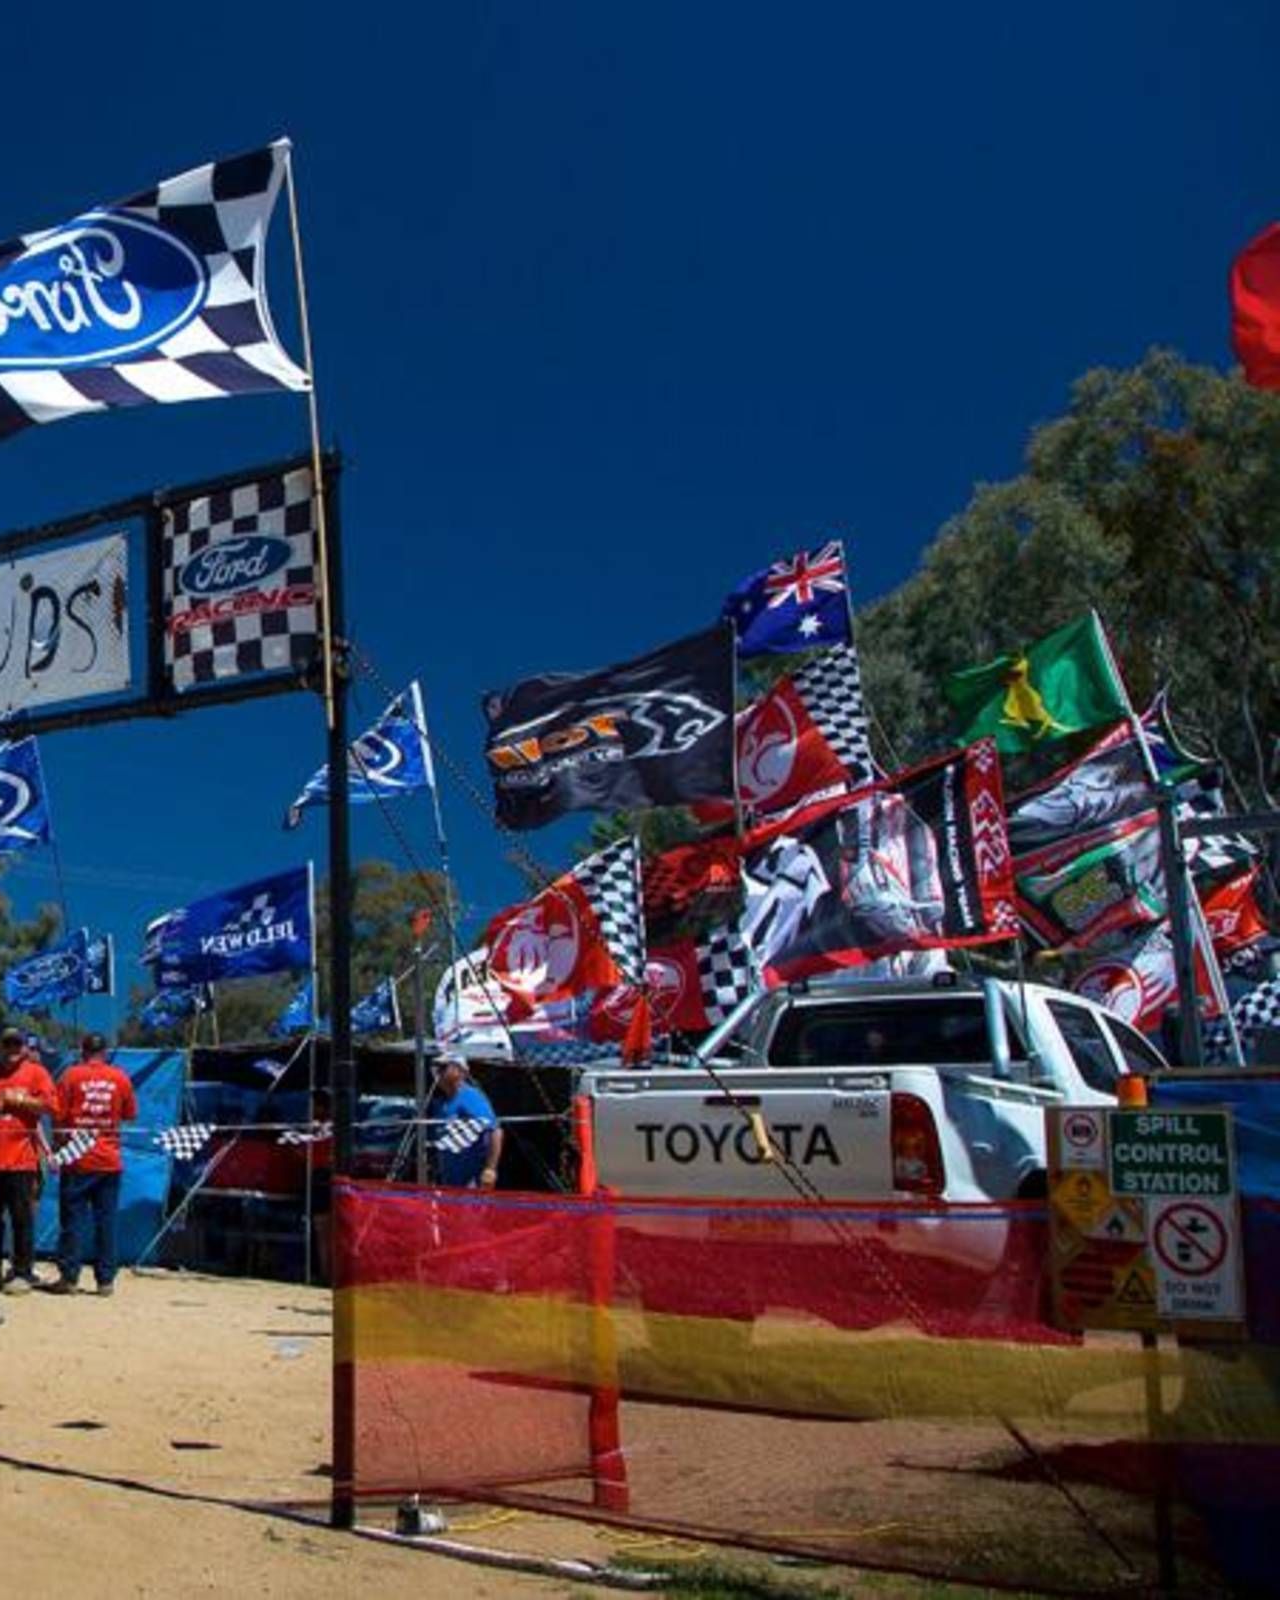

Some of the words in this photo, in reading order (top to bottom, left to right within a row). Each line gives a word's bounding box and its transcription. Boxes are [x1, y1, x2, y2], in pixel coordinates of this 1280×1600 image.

[195, 538, 270, 590] Ford
[1135, 1115, 1201, 1136] SPILL
[635, 1122, 841, 1167] TOYOTA
[1114, 1142, 1226, 1164] CONTROL
[1123, 1171, 1219, 1193] STATION
